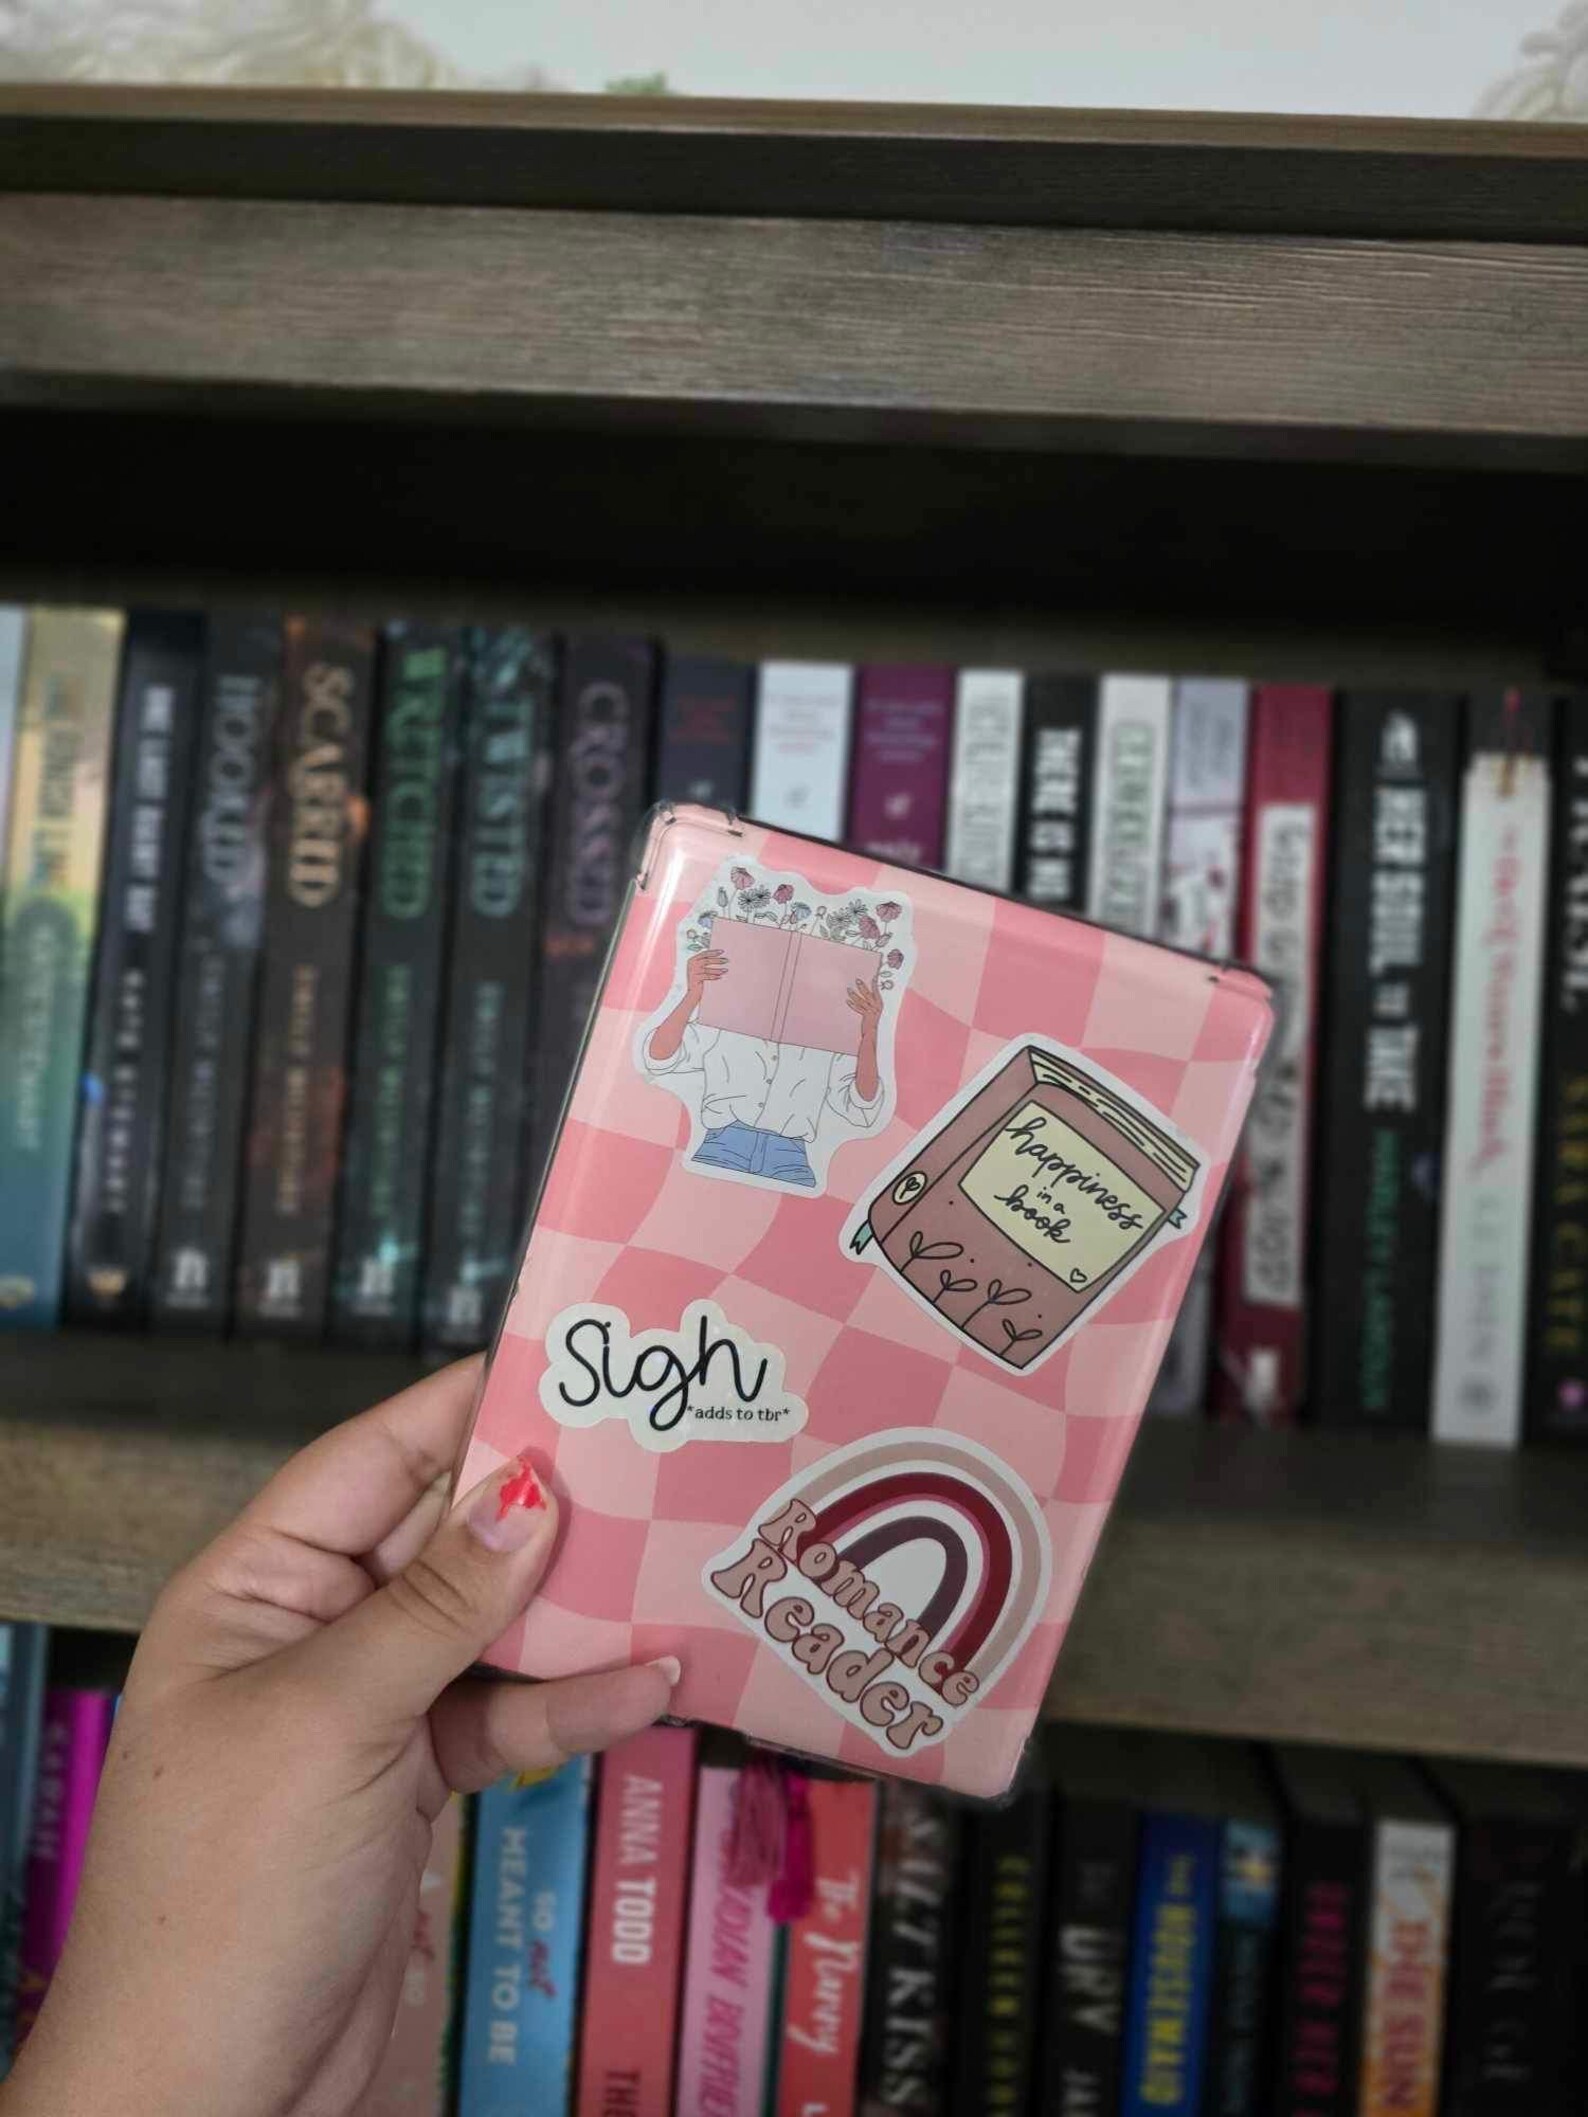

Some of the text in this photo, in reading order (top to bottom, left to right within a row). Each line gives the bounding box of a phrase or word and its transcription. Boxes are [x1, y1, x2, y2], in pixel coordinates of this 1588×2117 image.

[994, 1183, 1072, 1245] book
[1003, 1116, 1144, 1231] happiness
[1036, 1186, 1066, 1216] in a
[558, 1314, 769, 1432] Sigh
[735, 1407, 754, 1421] to
[710, 1537, 945, 1750] Reader
[757, 1498, 981, 1709] Romance
[531, 1889, 558, 1932] SO
[610, 1774, 665, 1966] ANNA TODD
[487, 1826, 528, 2066] MEANT TO BE
[787, 1868, 861, 2056] The Nanny
[881, 1964, 938, 2105] KISS
